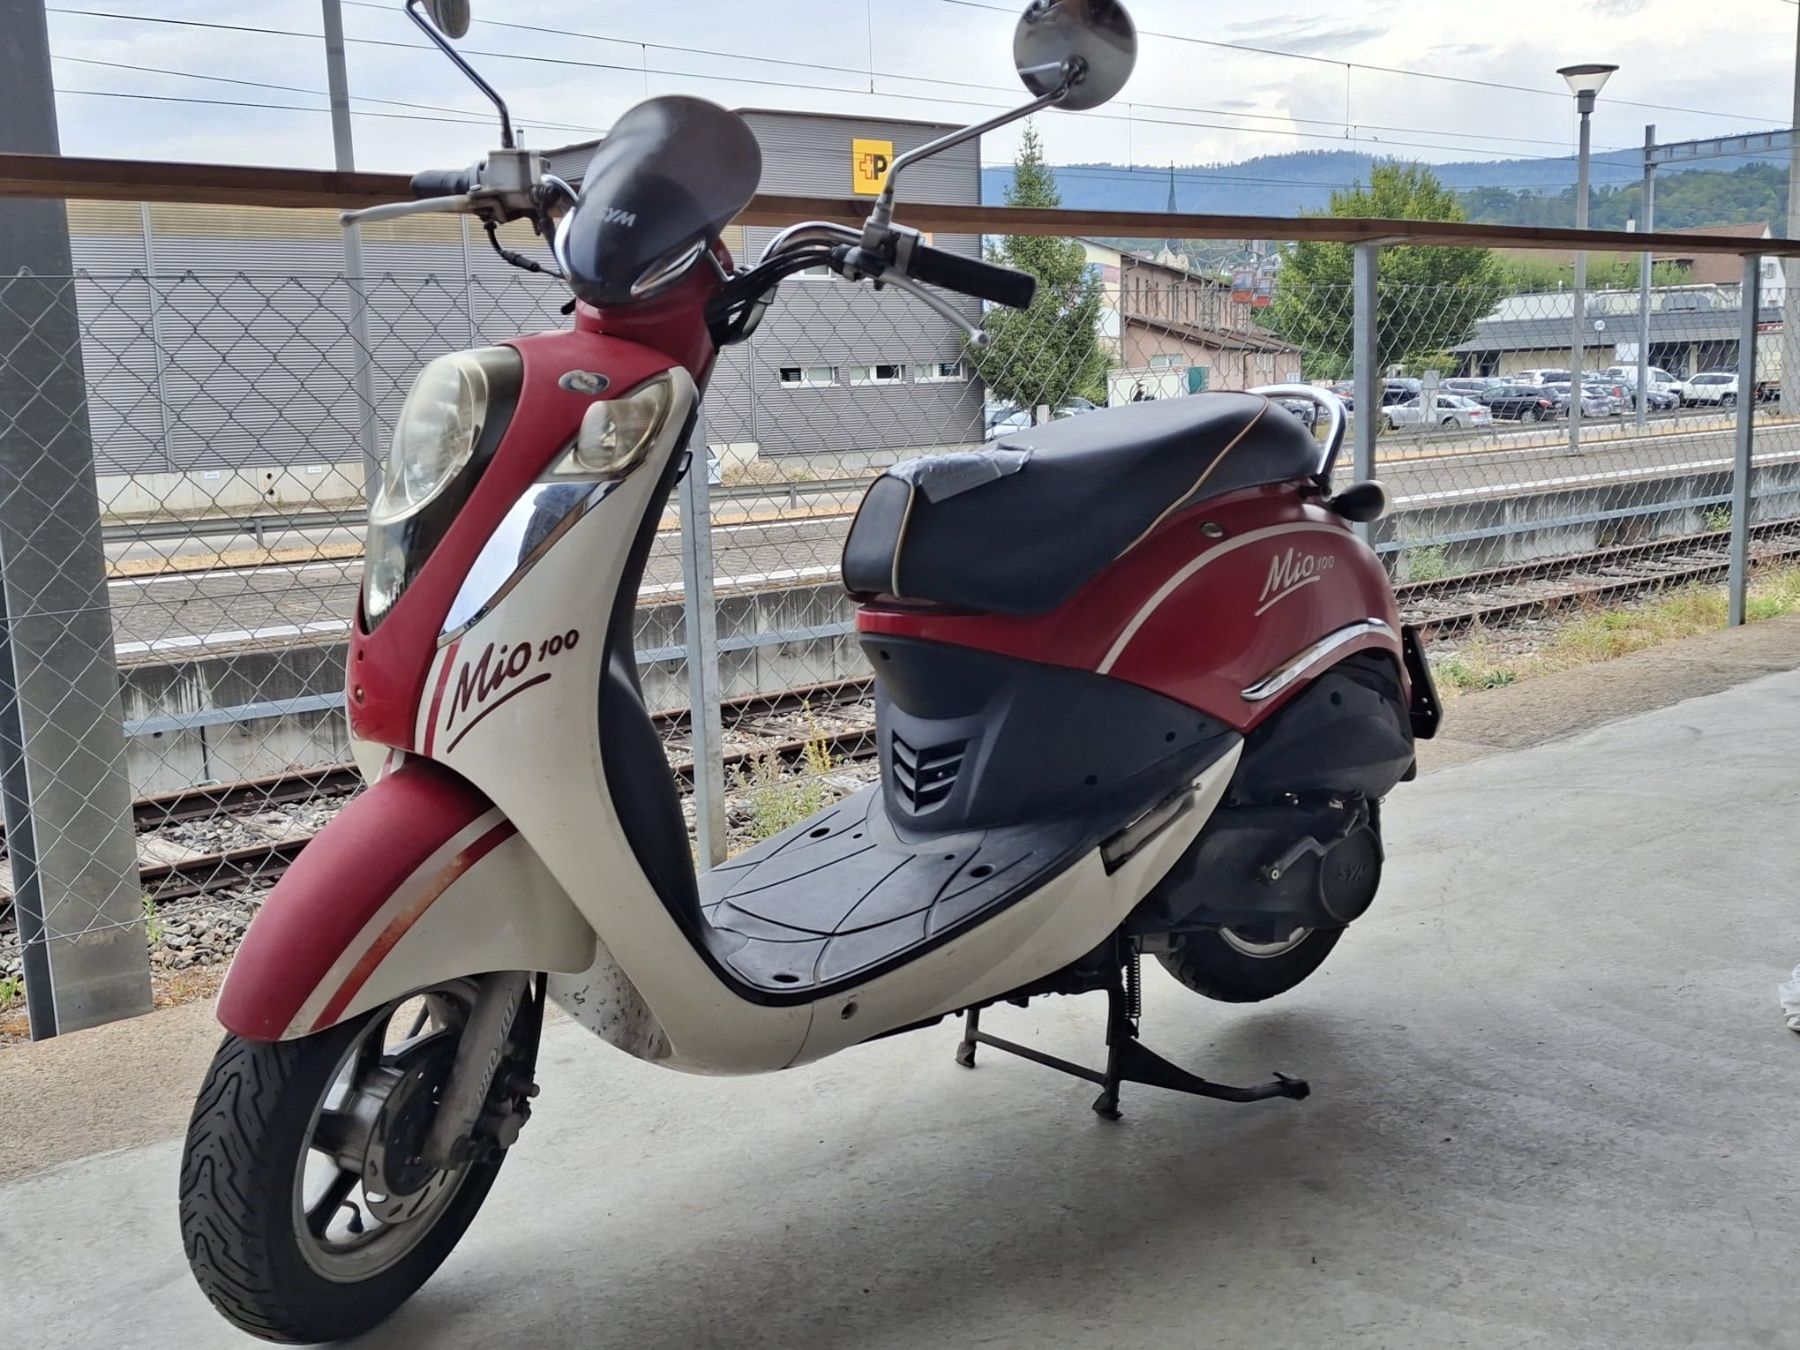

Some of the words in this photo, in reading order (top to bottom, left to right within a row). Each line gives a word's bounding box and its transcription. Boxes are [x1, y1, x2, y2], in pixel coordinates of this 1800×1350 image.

[873, 154, 888, 180] P
[1317, 555, 1335, 571] 100
[538, 629, 579, 662] 100
